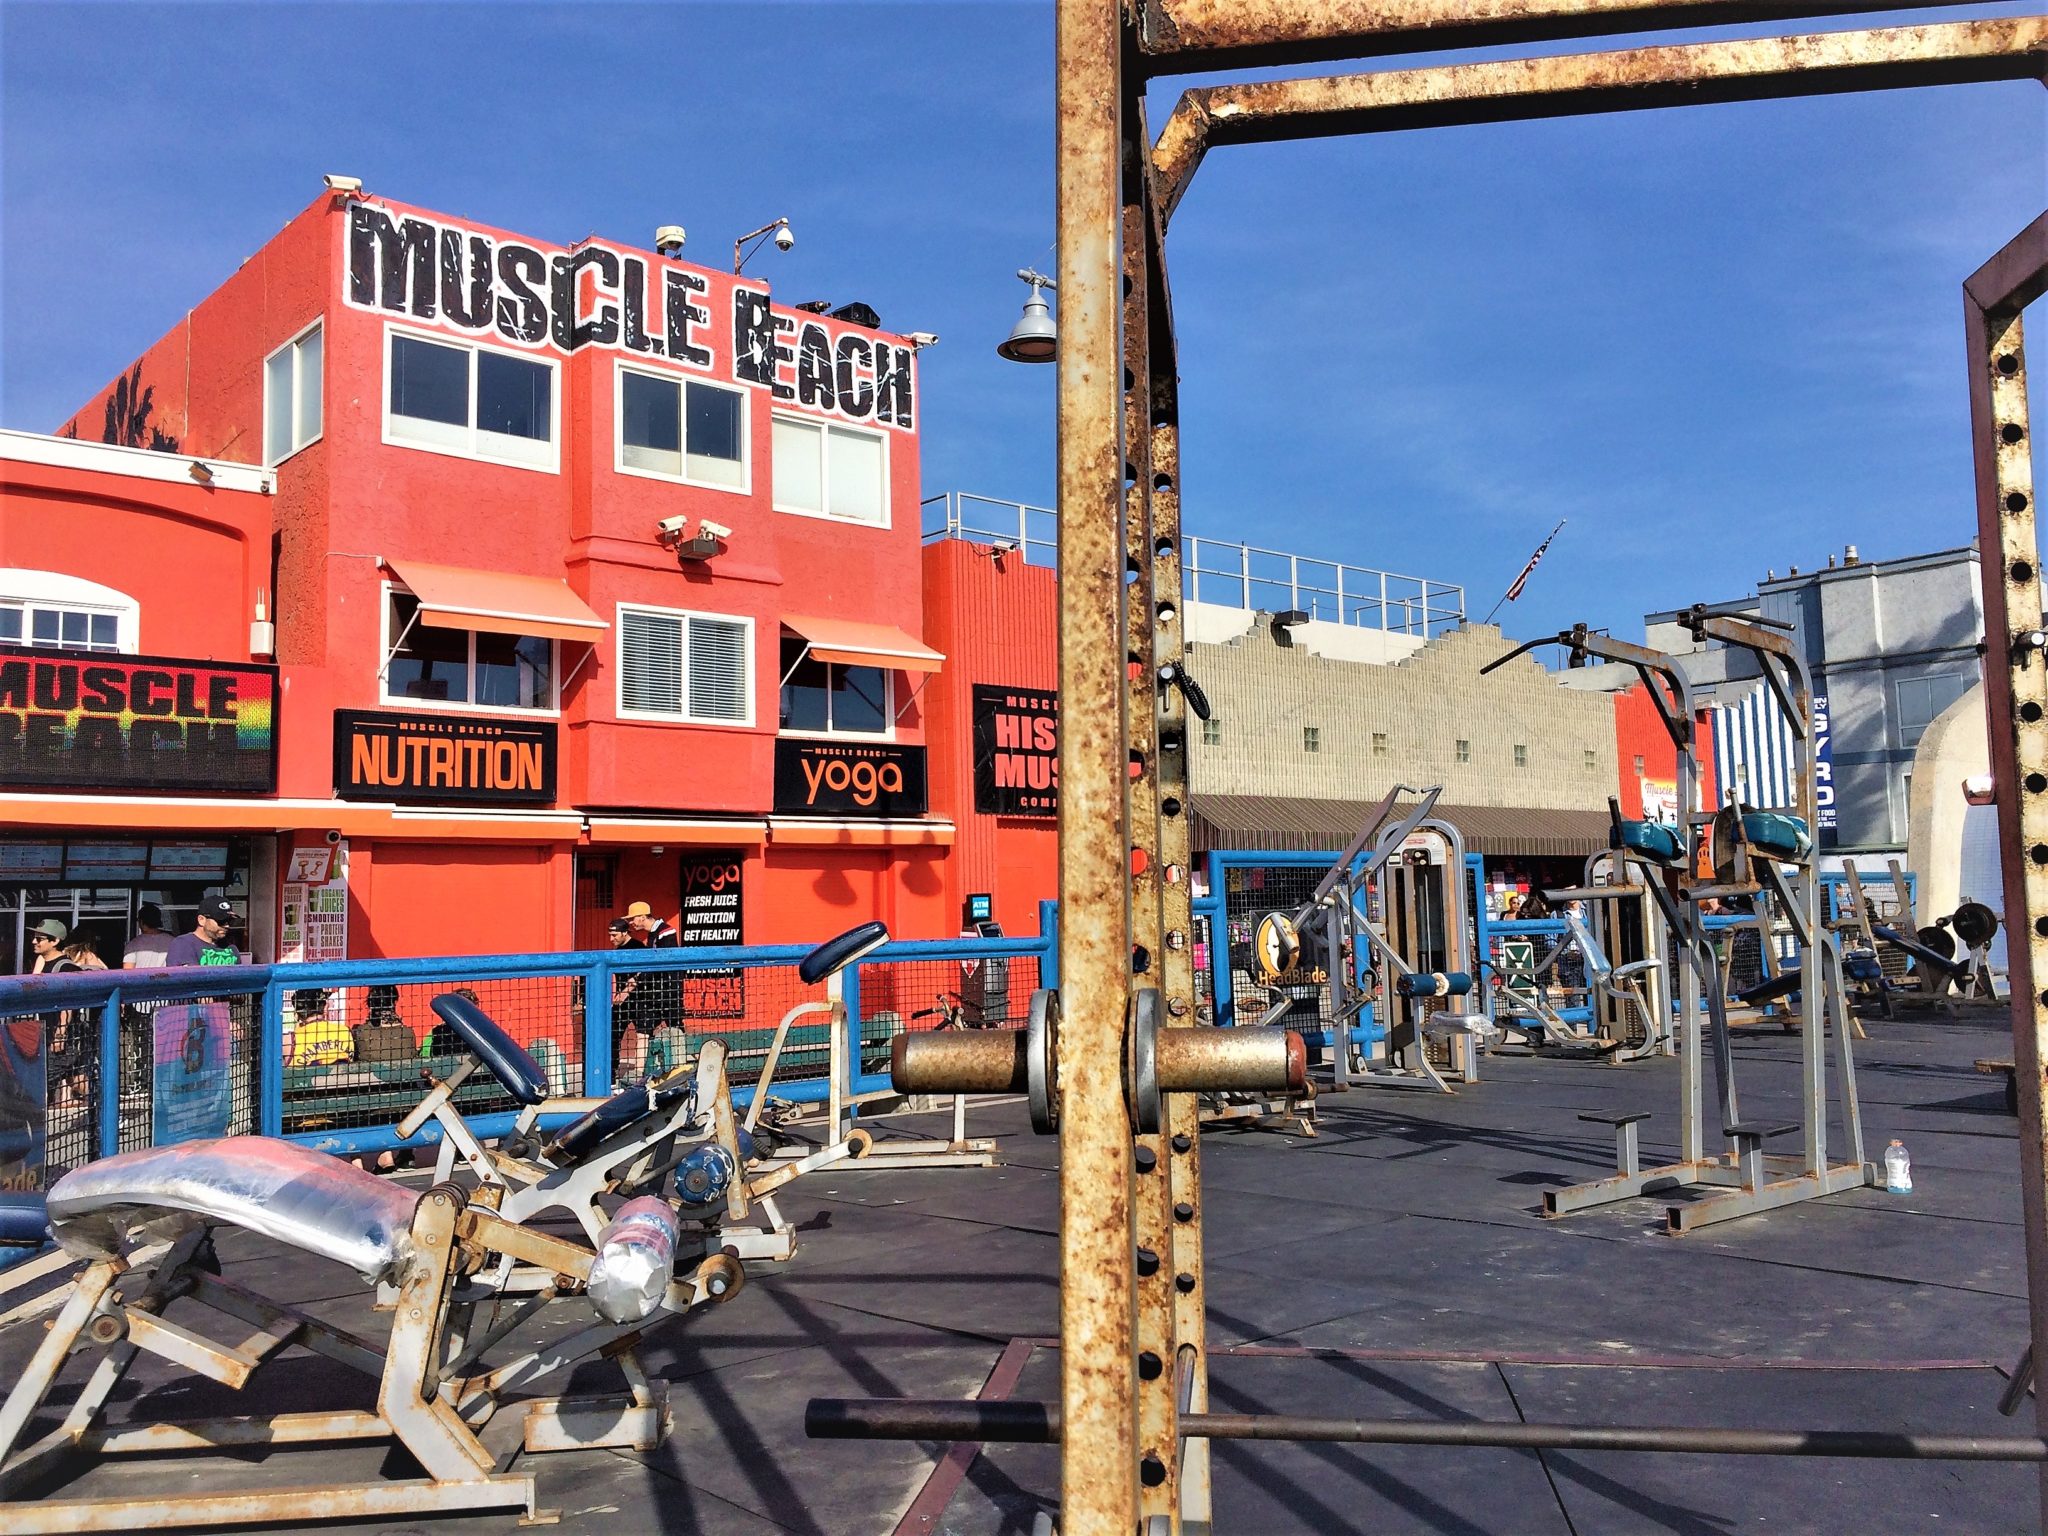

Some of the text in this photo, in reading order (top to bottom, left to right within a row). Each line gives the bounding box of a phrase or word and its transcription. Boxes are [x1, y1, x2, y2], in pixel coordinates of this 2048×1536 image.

[350, 205, 913, 428] MUSCLE BEACH
[0, 661, 237, 719] MUSCLE
[399, 722, 502, 736] MUSCLE BEACH
[995, 714, 1059, 751] HIS
[815, 747, 887, 757] MUSCLE BEACH
[352, 734, 543, 790] NUTRITION
[800, 758, 903, 807] yoga
[684, 864, 740, 892] yoga
[320, 889, 344, 898] ORGANIC
[684, 894, 738, 907] FRESH JUICE
[319, 898, 344, 912] JUICES
[307, 913, 345, 923] SMOOTHIES
[686, 912, 736, 924] NUTRITION
[320, 924, 344, 935] PROTEIN
[683, 928, 740, 942] GET HEALTHY
[320, 936, 344, 947] SHAKES
[1258, 966, 1327, 986] HeadBlade
[684, 978, 742, 992] MUSCLE
